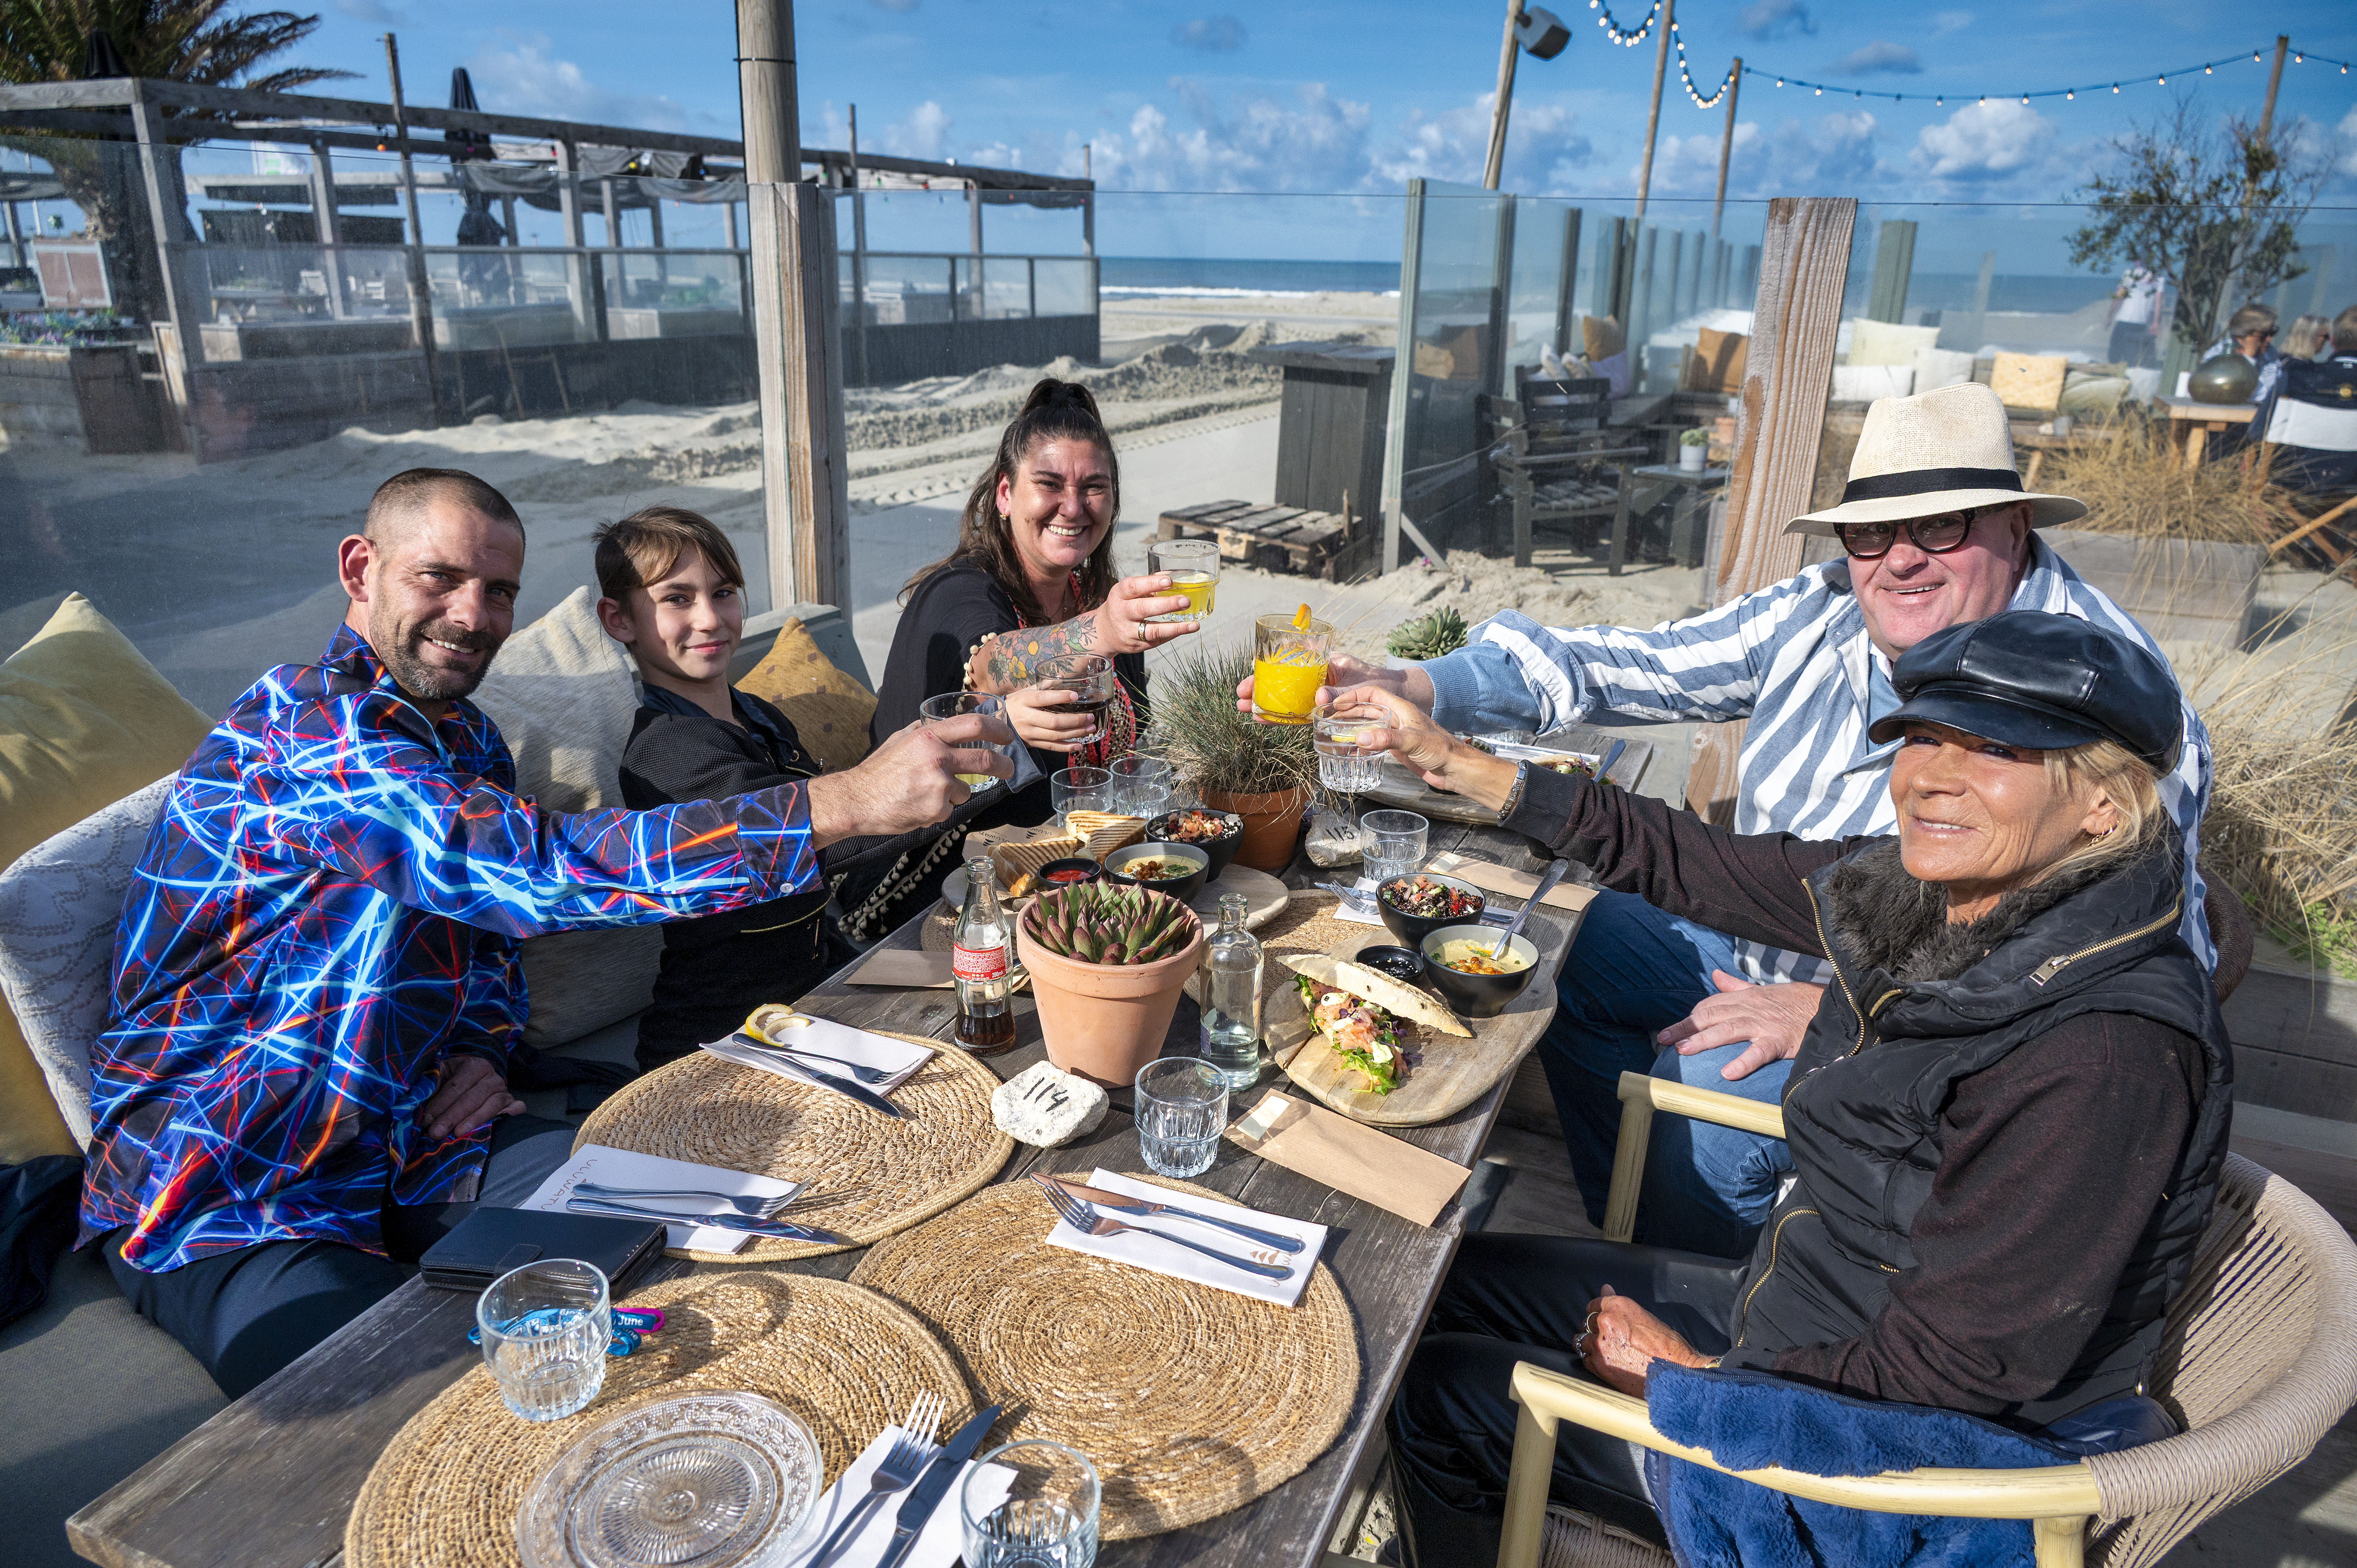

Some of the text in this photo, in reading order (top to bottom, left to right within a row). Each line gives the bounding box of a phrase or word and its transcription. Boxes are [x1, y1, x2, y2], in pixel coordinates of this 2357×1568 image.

[979, 832, 1010, 842] ULUWAT
[1326, 826, 1354, 840] 115
[1023, 1077, 1069, 1112] 114
[541, 1159, 597, 1210] ULUWATU
[618, 1315, 643, 1326] June
